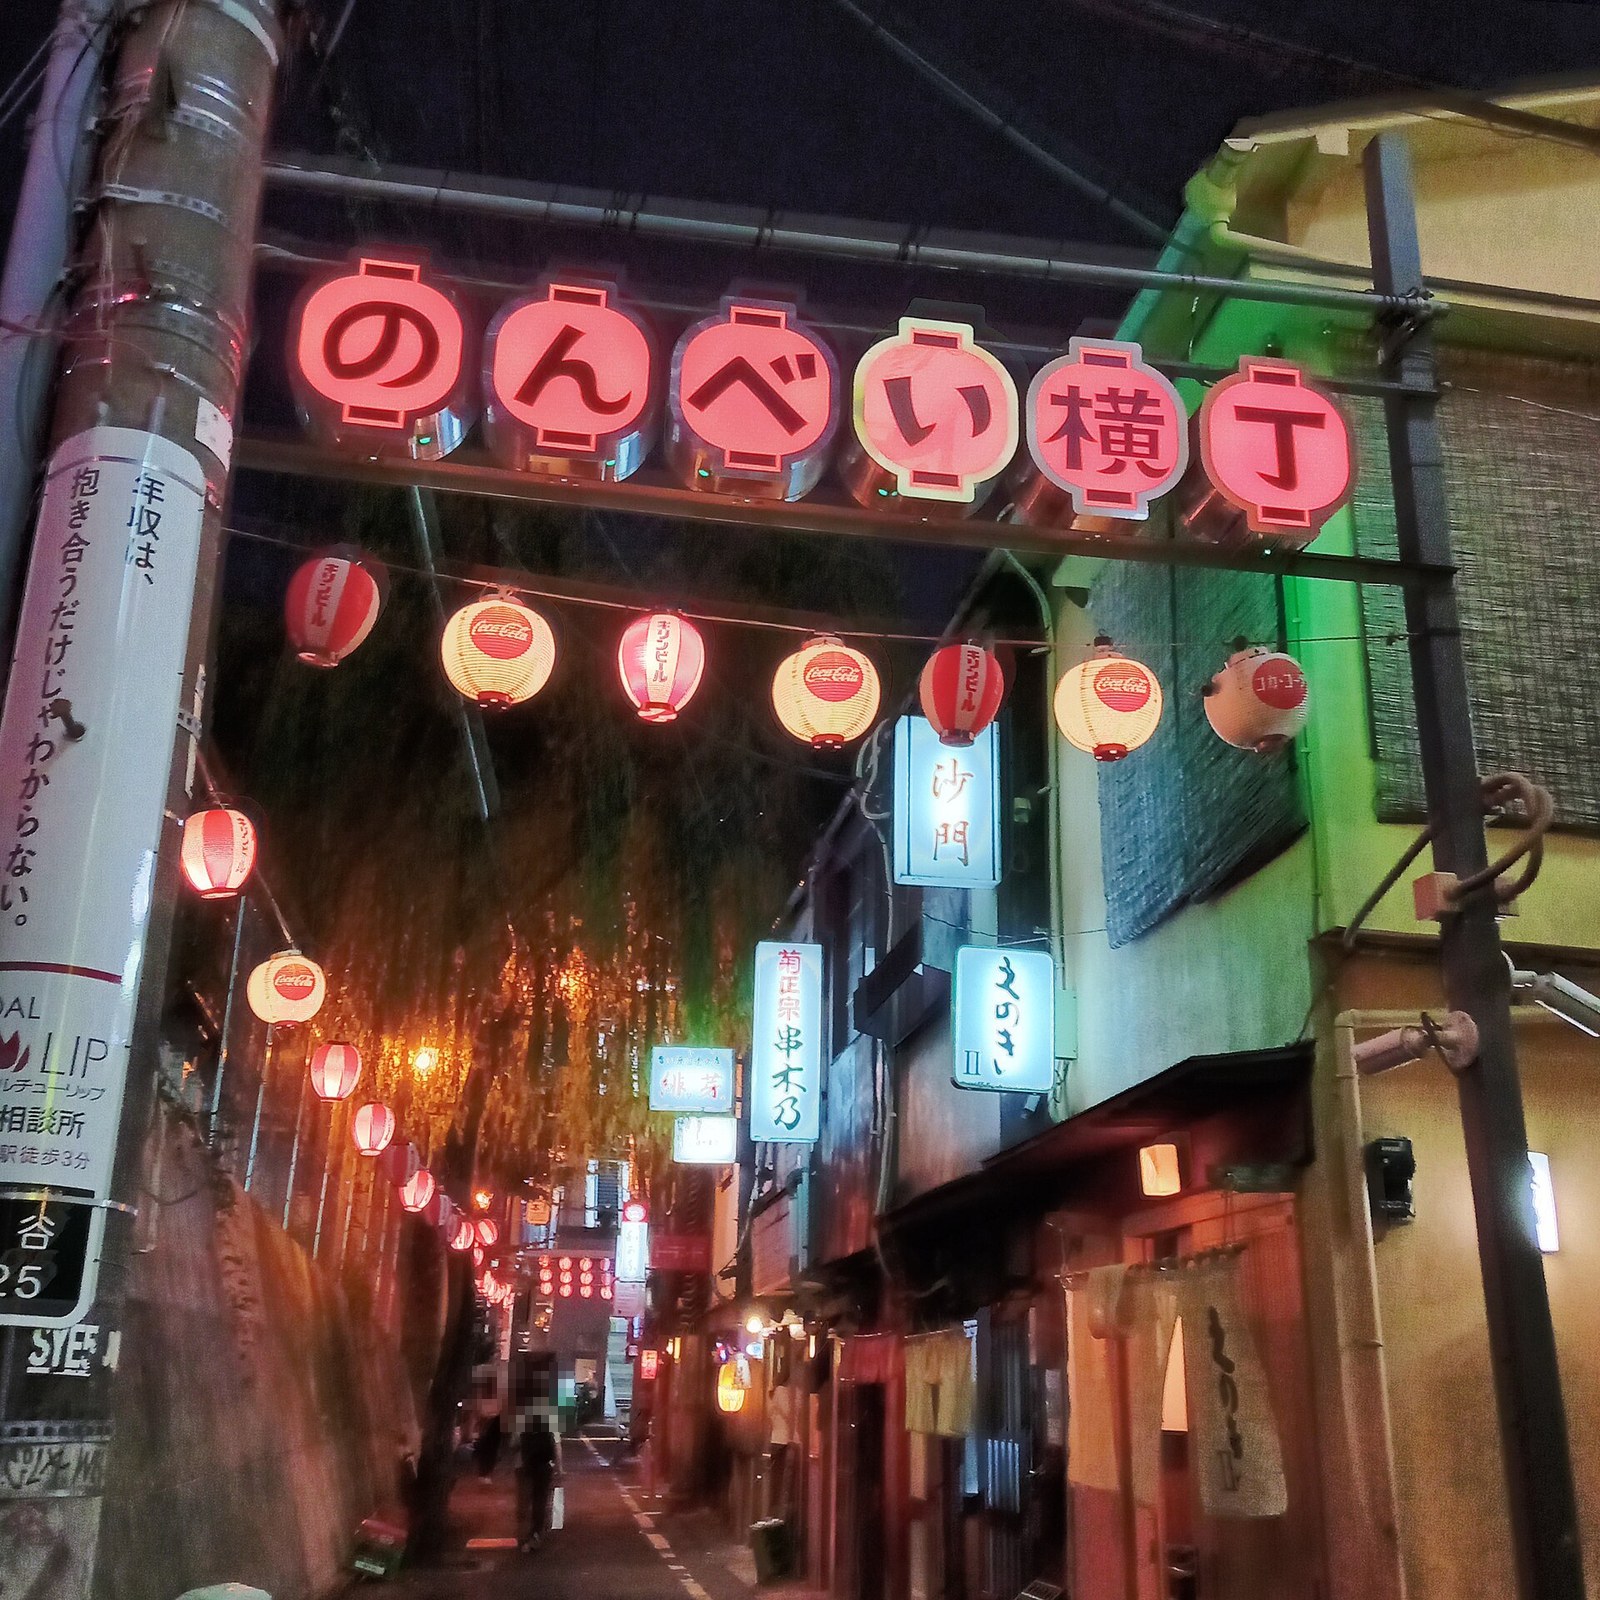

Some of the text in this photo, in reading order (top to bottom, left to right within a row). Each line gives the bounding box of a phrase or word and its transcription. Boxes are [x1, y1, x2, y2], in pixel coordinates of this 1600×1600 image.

[126, 472, 165, 585] 年収は、
[471, 619, 531, 642] Coca-Cola
[651, 620, 671, 683] キリンビール
[804, 665, 863, 683] Coca-Cola
[1095, 676, 1150, 695] Coca-Cola
[931, 758, 975, 867] 沙門
[0, 996, 41, 1019] AL
